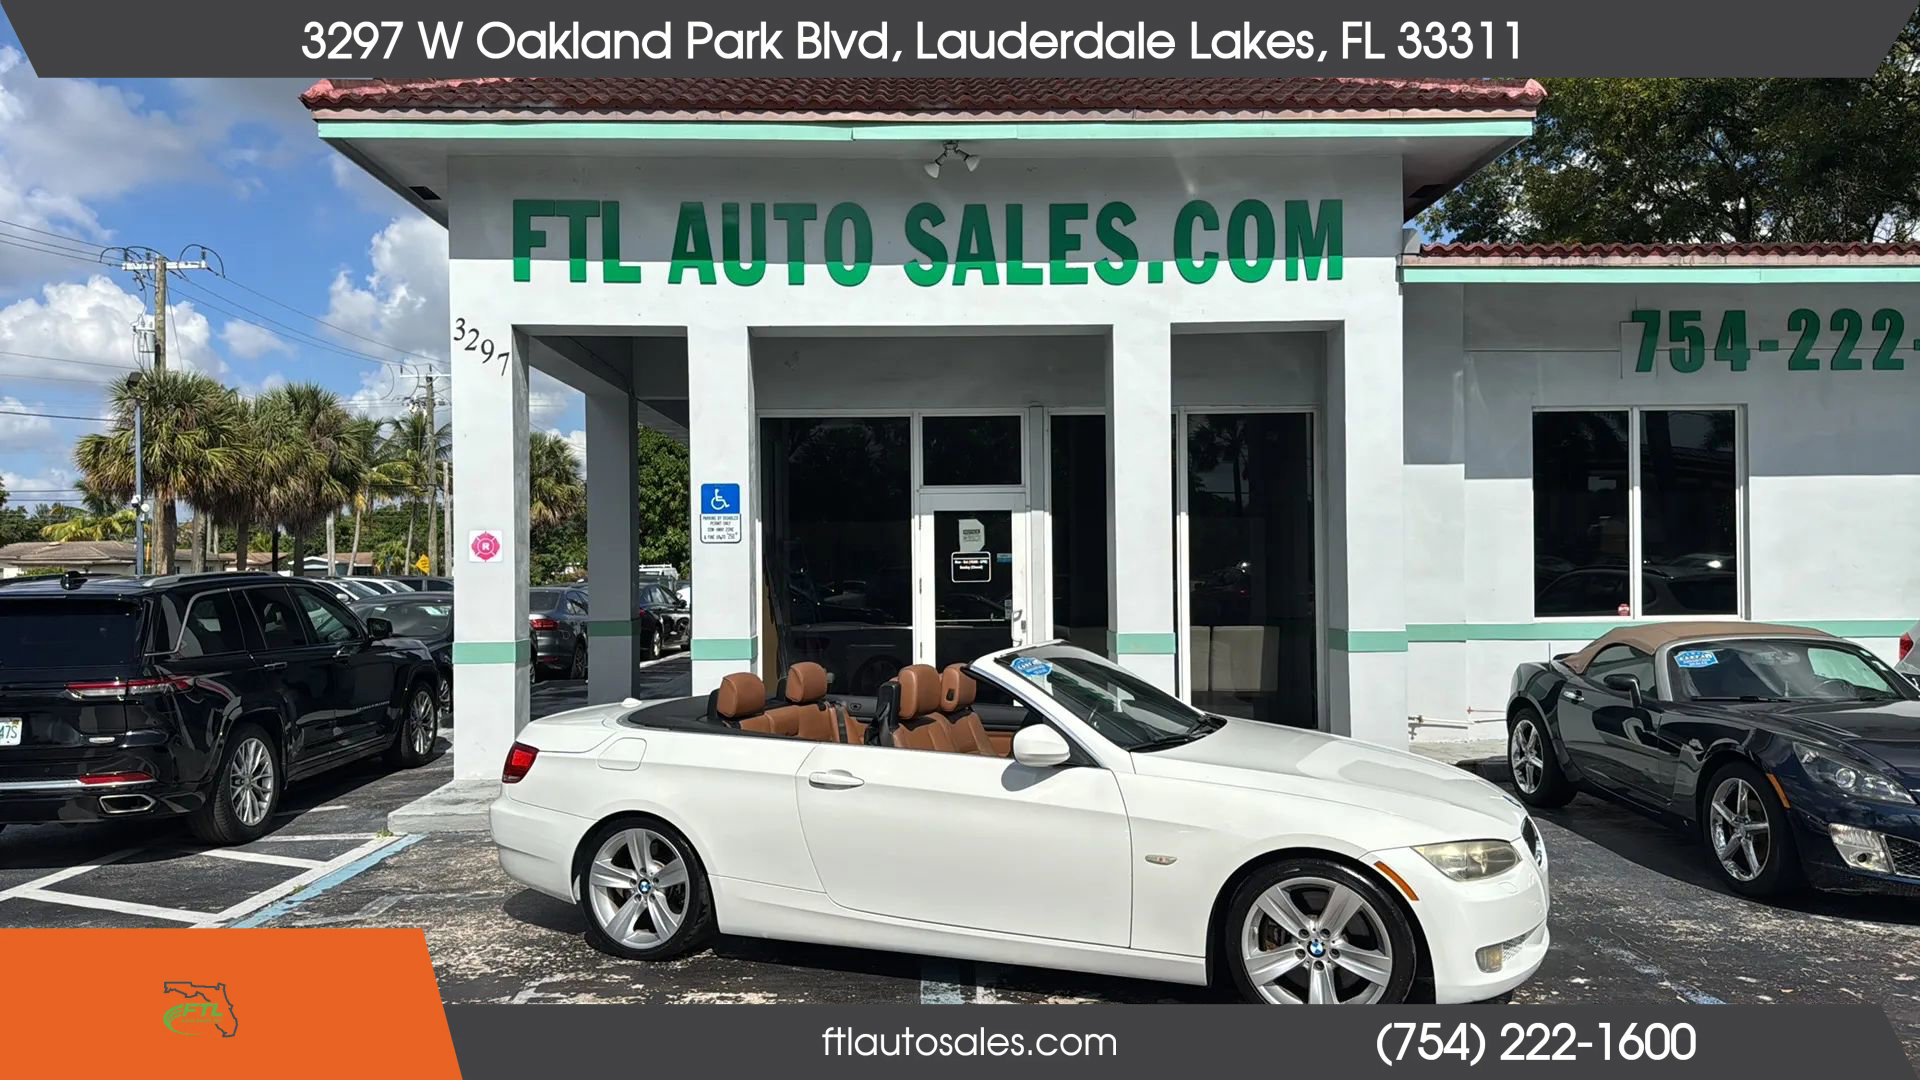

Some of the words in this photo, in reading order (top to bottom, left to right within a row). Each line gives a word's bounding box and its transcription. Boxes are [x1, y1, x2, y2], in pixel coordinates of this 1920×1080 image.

[512, 200, 643, 285] FTL
[668, 202, 873, 288] AUTO
[904, 199, 1345, 288] SALES.COM
[453, 317, 511, 377] 3297
